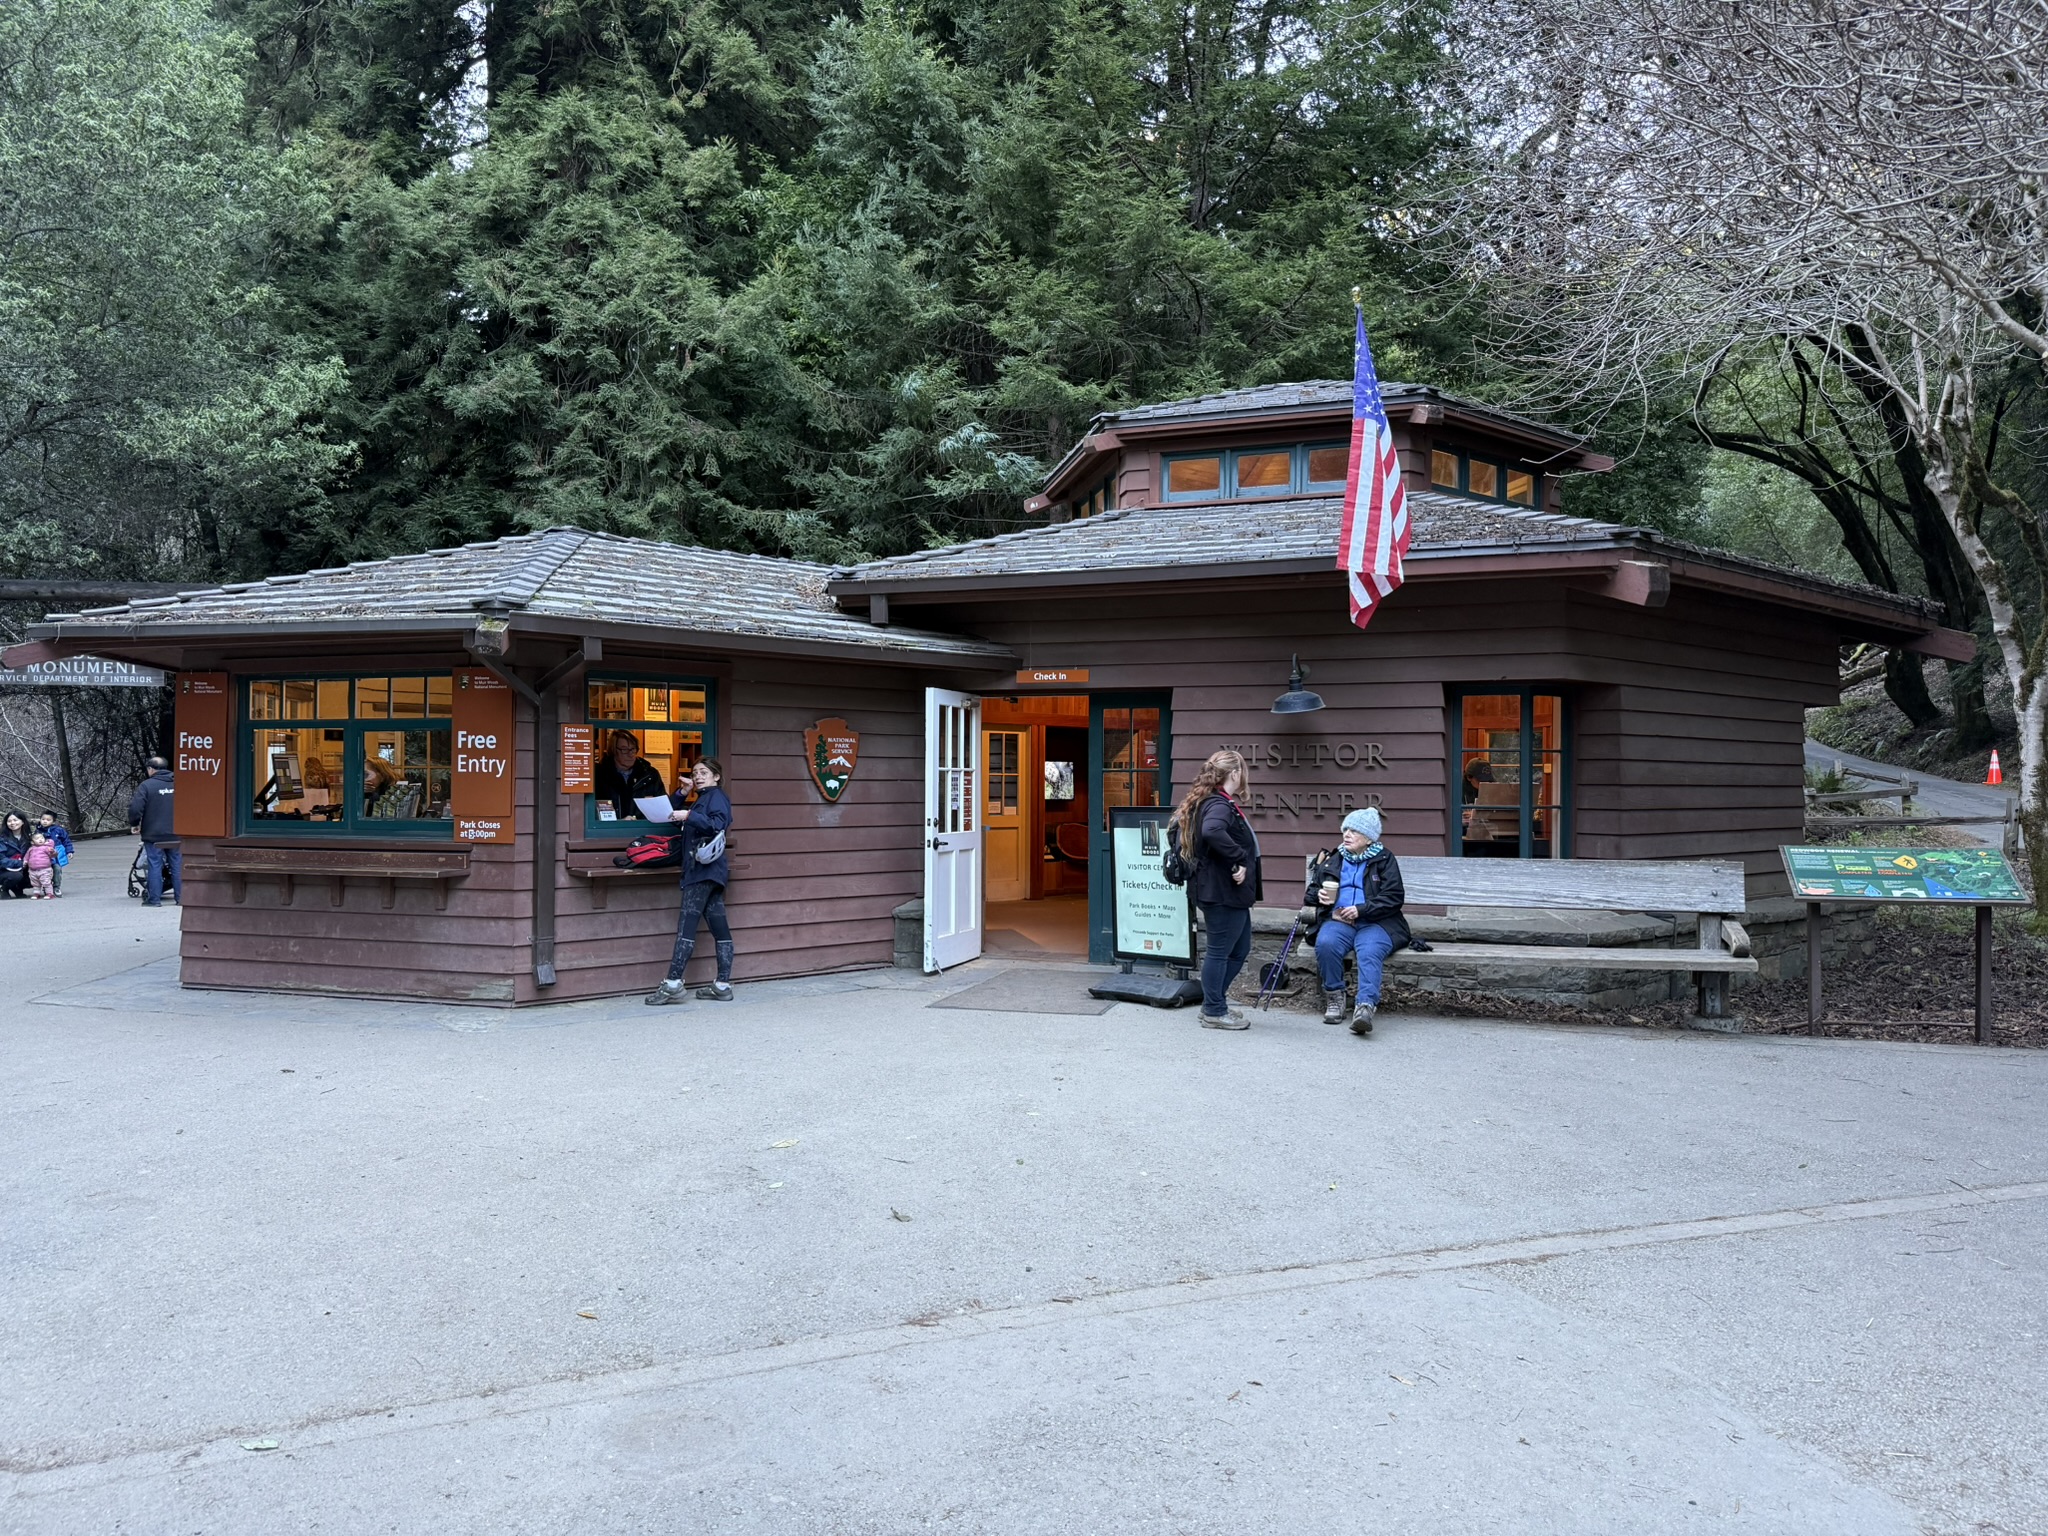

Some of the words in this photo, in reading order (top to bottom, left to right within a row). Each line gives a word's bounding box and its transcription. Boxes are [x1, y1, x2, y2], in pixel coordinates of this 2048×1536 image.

[33, 675, 89, 683] DEPARTMENT
[94, 675, 105, 683] OF
[110, 675, 152, 683] INTERIOR
[1034, 672, 1056, 680] Check
[1058, 672, 1066, 680] In
[179, 731, 213, 749] Free
[457, 731, 497, 749] Free
[179, 753, 221, 776] Entry
[457, 754, 506, 778] Entry
[1233, 792, 1388, 818] ENTER
[460, 820, 476, 829] Park
[478, 820, 501, 829] Closes
[468, 829, 496, 840] 5:00pm
[1122, 880, 1173, 891] Tickets/Check
